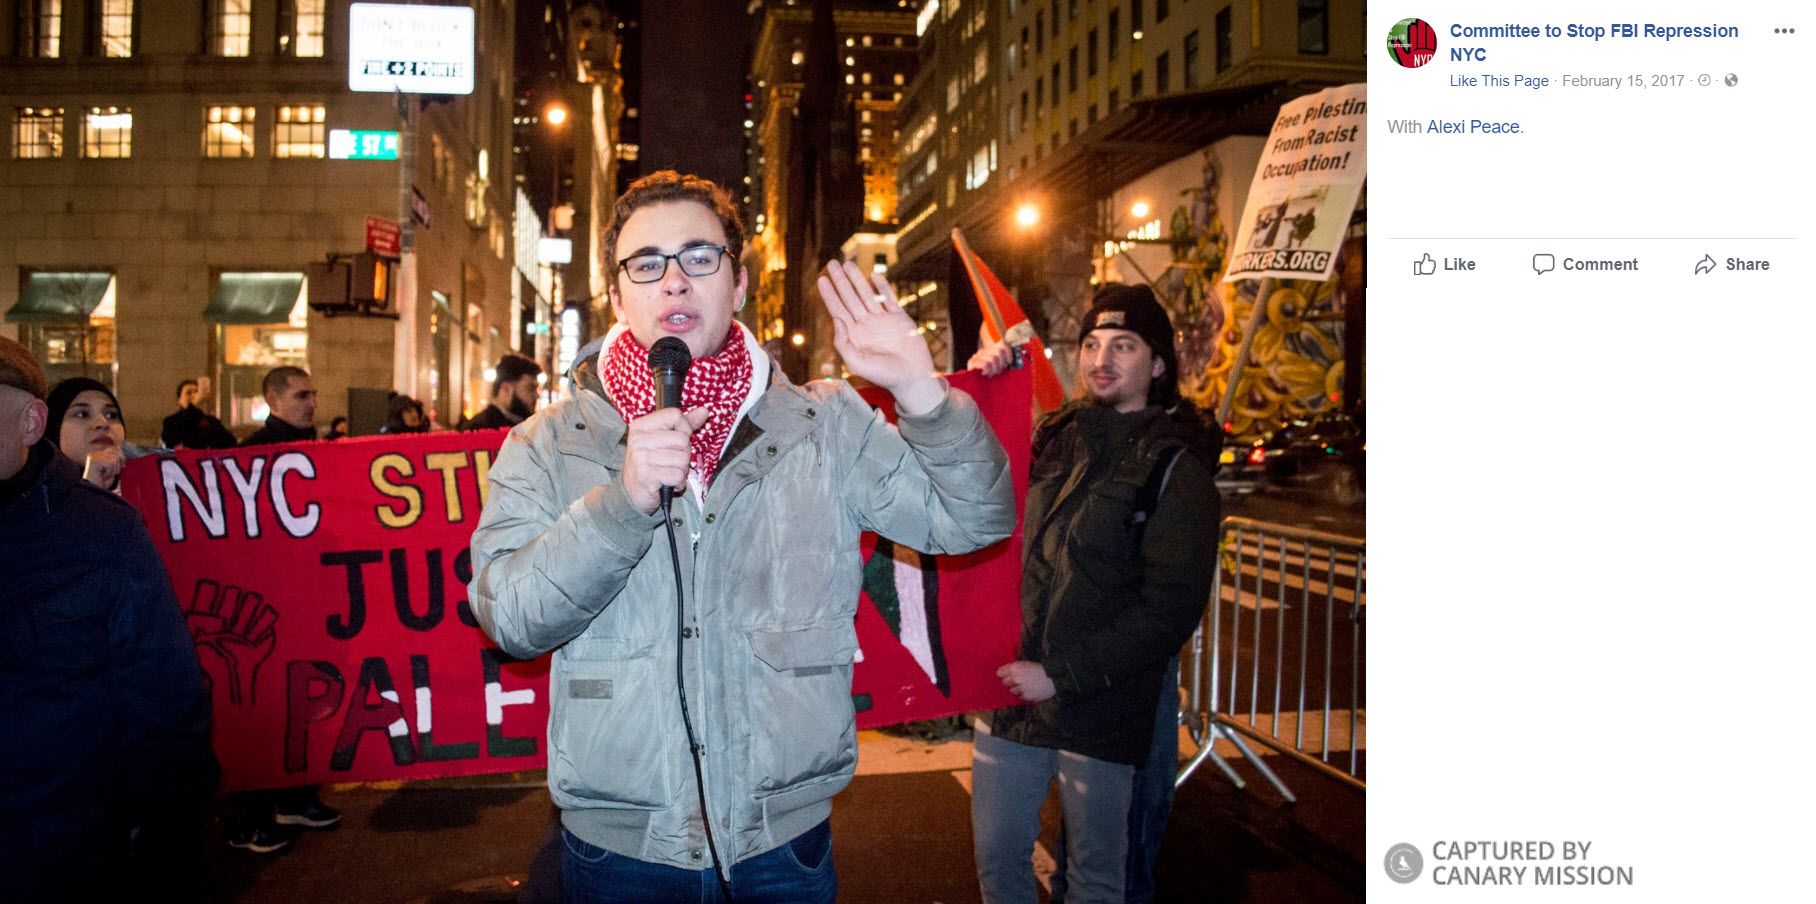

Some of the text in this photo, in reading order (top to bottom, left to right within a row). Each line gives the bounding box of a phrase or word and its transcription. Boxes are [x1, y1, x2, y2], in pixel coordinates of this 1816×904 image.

[1275, 98, 1367, 132] Free Palestin
[1272, 125, 1358, 155] From Racist
[159, 452, 321, 542] NYC
